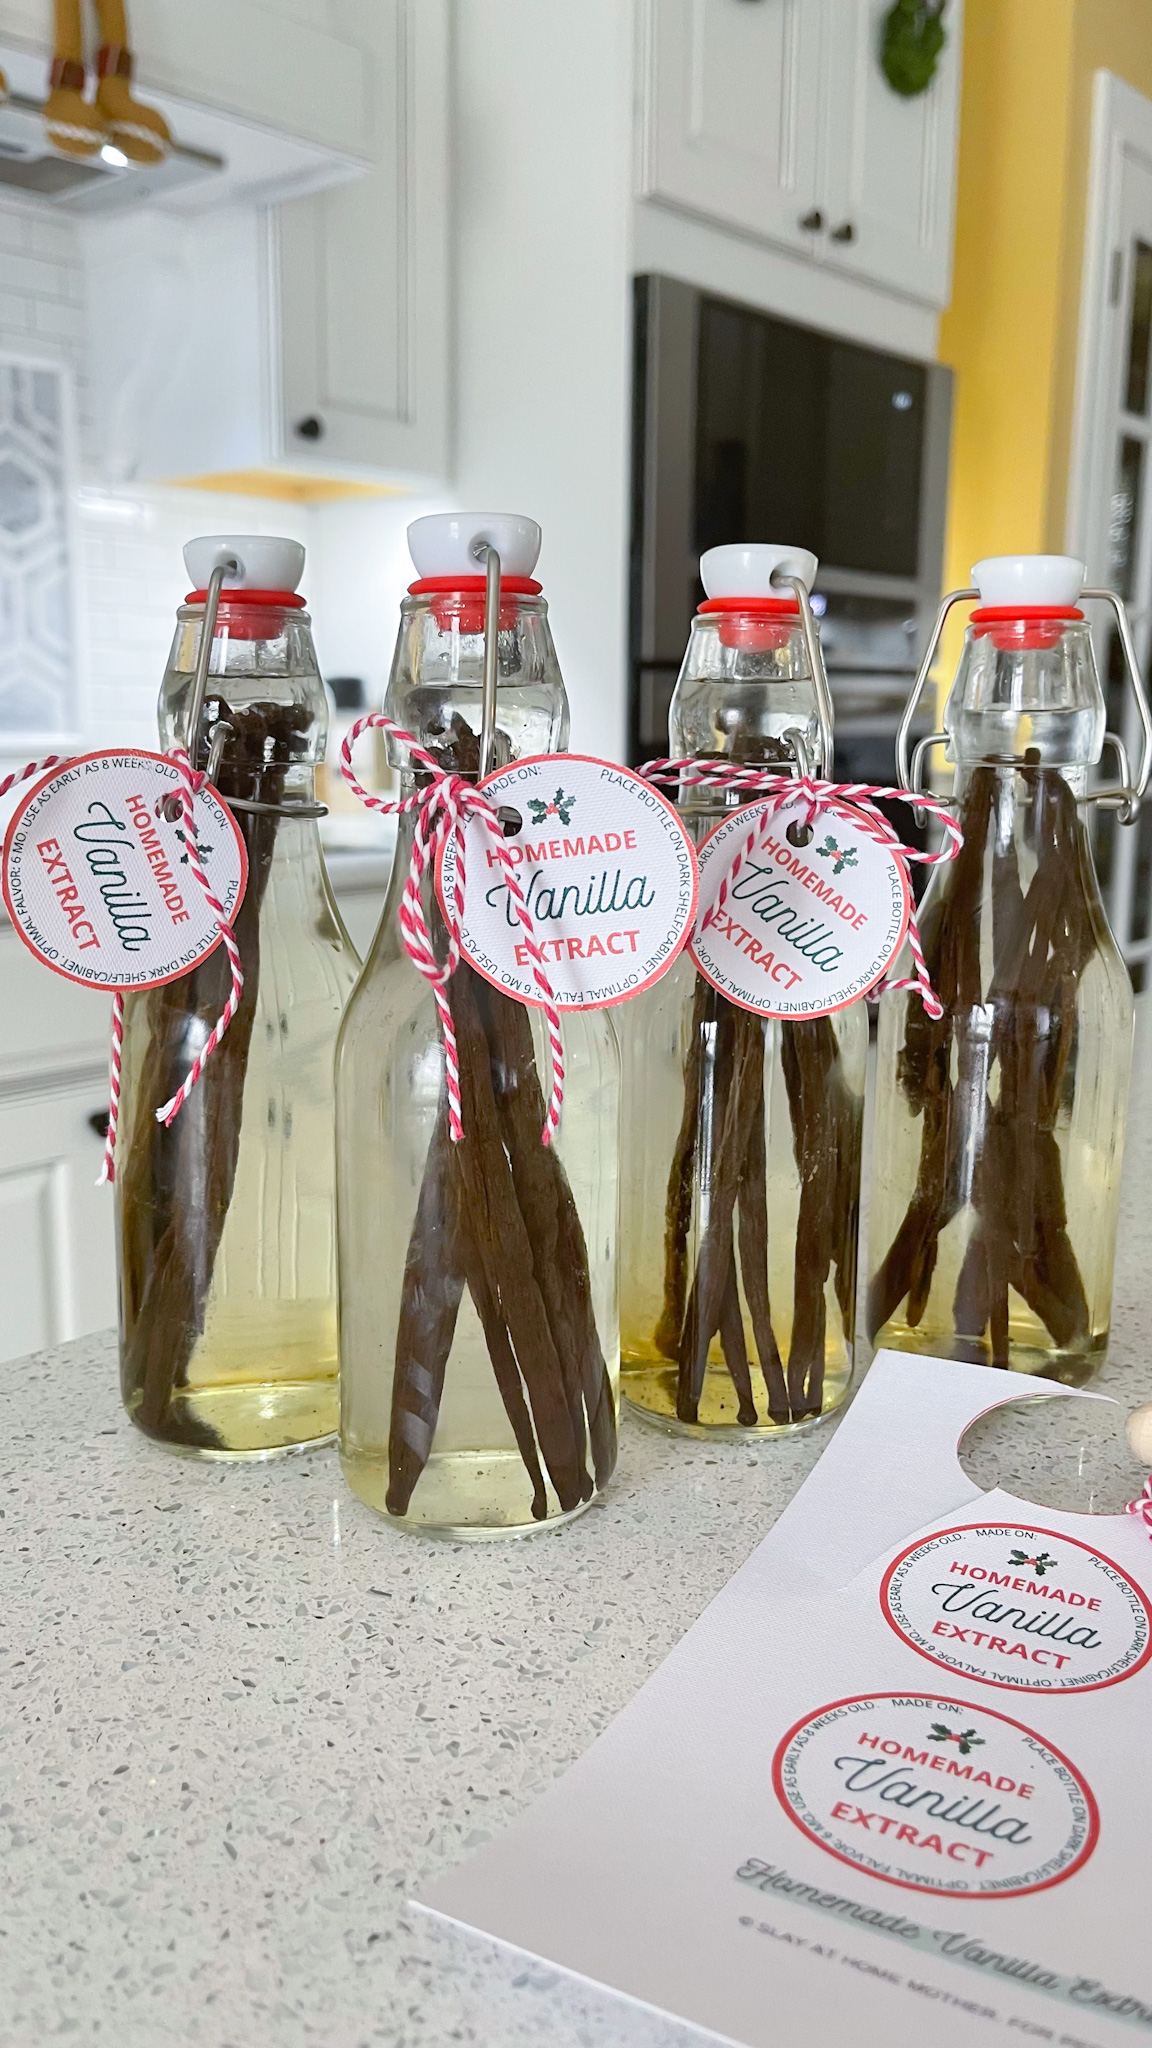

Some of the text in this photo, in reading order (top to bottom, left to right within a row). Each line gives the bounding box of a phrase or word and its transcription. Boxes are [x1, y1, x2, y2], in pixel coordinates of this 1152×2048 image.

[85, 761, 99, 775] AS
[102, 759, 110, 770] 8
[112, 758, 152, 770] WEEKS
[155, 763, 179, 781] OLD.
[49, 768, 82, 794] EARLY
[481, 765, 542, 799] MADE ON:
[600, 769, 639, 793] PLACE
[37, 790, 51, 807] AS
[196, 790, 229, 831] ADE ON:
[637, 789, 675, 830] BOTTLE
[21, 804, 40, 827] USE
[714, 829, 727, 845] AS
[725, 823, 734, 832] 8
[732, 804, 768, 827] WEEKS
[13, 831, 28, 854] MO.
[485, 830, 637, 868] HOMEMADE
[669, 831, 684, 851] ON
[11, 856, 21, 864] 6
[125, 794, 190, 925] HOMEMADE
[676, 853, 690, 887] DARK
[74, 801, 152, 952] Vanilla
[444, 874, 454, 884] 8
[760, 835, 868, 931] HOMEMADE
[886, 864, 902, 898] PLACE
[10, 866, 28, 915] FALVOR:
[37, 838, 101, 950] EXTRACT
[444, 885, 455, 900] AS
[486, 869, 655, 926] Vanilla
[732, 861, 843, 972] Vanilla
[886, 901, 902, 943] BOTTLE
[23, 915, 59, 960] OPTIMAL
[196, 921, 221, 953] OTTLE
[464, 939, 481, 953] AS
[514, 930, 640, 966] EXTRACT
[693, 937, 702, 945] 6
[709, 907, 803, 990] EXTRACT
[180, 949, 197, 966] ON
[476, 953, 498, 974] USE
[697, 945, 728, 985] FALVOR:
[877, 944, 892, 962] ON
[149, 960, 180, 979] DARK
[501, 970, 522, 990] MO.
[855, 961, 882, 987] DARK
[523, 984, 531, 994] 6
[586, 973, 638, 1000] OPTIMAL
[727, 980, 771, 1009] OPTIMAL
[938, 1533, 966, 1545] OLD.
[975, 1529, 1037, 1540] MADE ON:
[907, 1541, 940, 1562] WEEKS
[896, 1566, 908, 1578] AS
[1088, 1557, 1122, 1581] PLACE
[890, 1577, 902, 1601] EARLY
[949, 1561, 1102, 1611] HOMEMADE
[1116, 1581, 1144, 1614] BOTTLE
[890, 1602, 902, 1612] AS
[931, 1583, 1102, 1649] Vanilla
[894, 1613, 912, 1629] USE
[1134, 1615, 1147, 1630] ON
[932, 1620, 1072, 1670] EXTRACT
[1130, 1630, 1147, 1653] DARK
[990, 1671, 1052, 1687] OPTIMAL
[892, 1698, 964, 1715] MADE ON:
[808, 1708, 848, 1731] WEEKS
[794, 1735, 808, 1748] AS
[802, 1728, 815, 1737] 8
[1021, 1736, 1059, 1766] PLACE
[857, 1732, 1035, 1800] HOMEMADE
[1053, 1766, 1084, 1805] BOTTLE
[834, 1756, 1032, 1845] Vanilla
[1072, 1806, 1086, 1824] ON
[830, 1801, 995, 1868] EXTRACT
[736, 1857, 920, 1940] Homemade
[932, 1930, 1060, 1990] Vanilla
